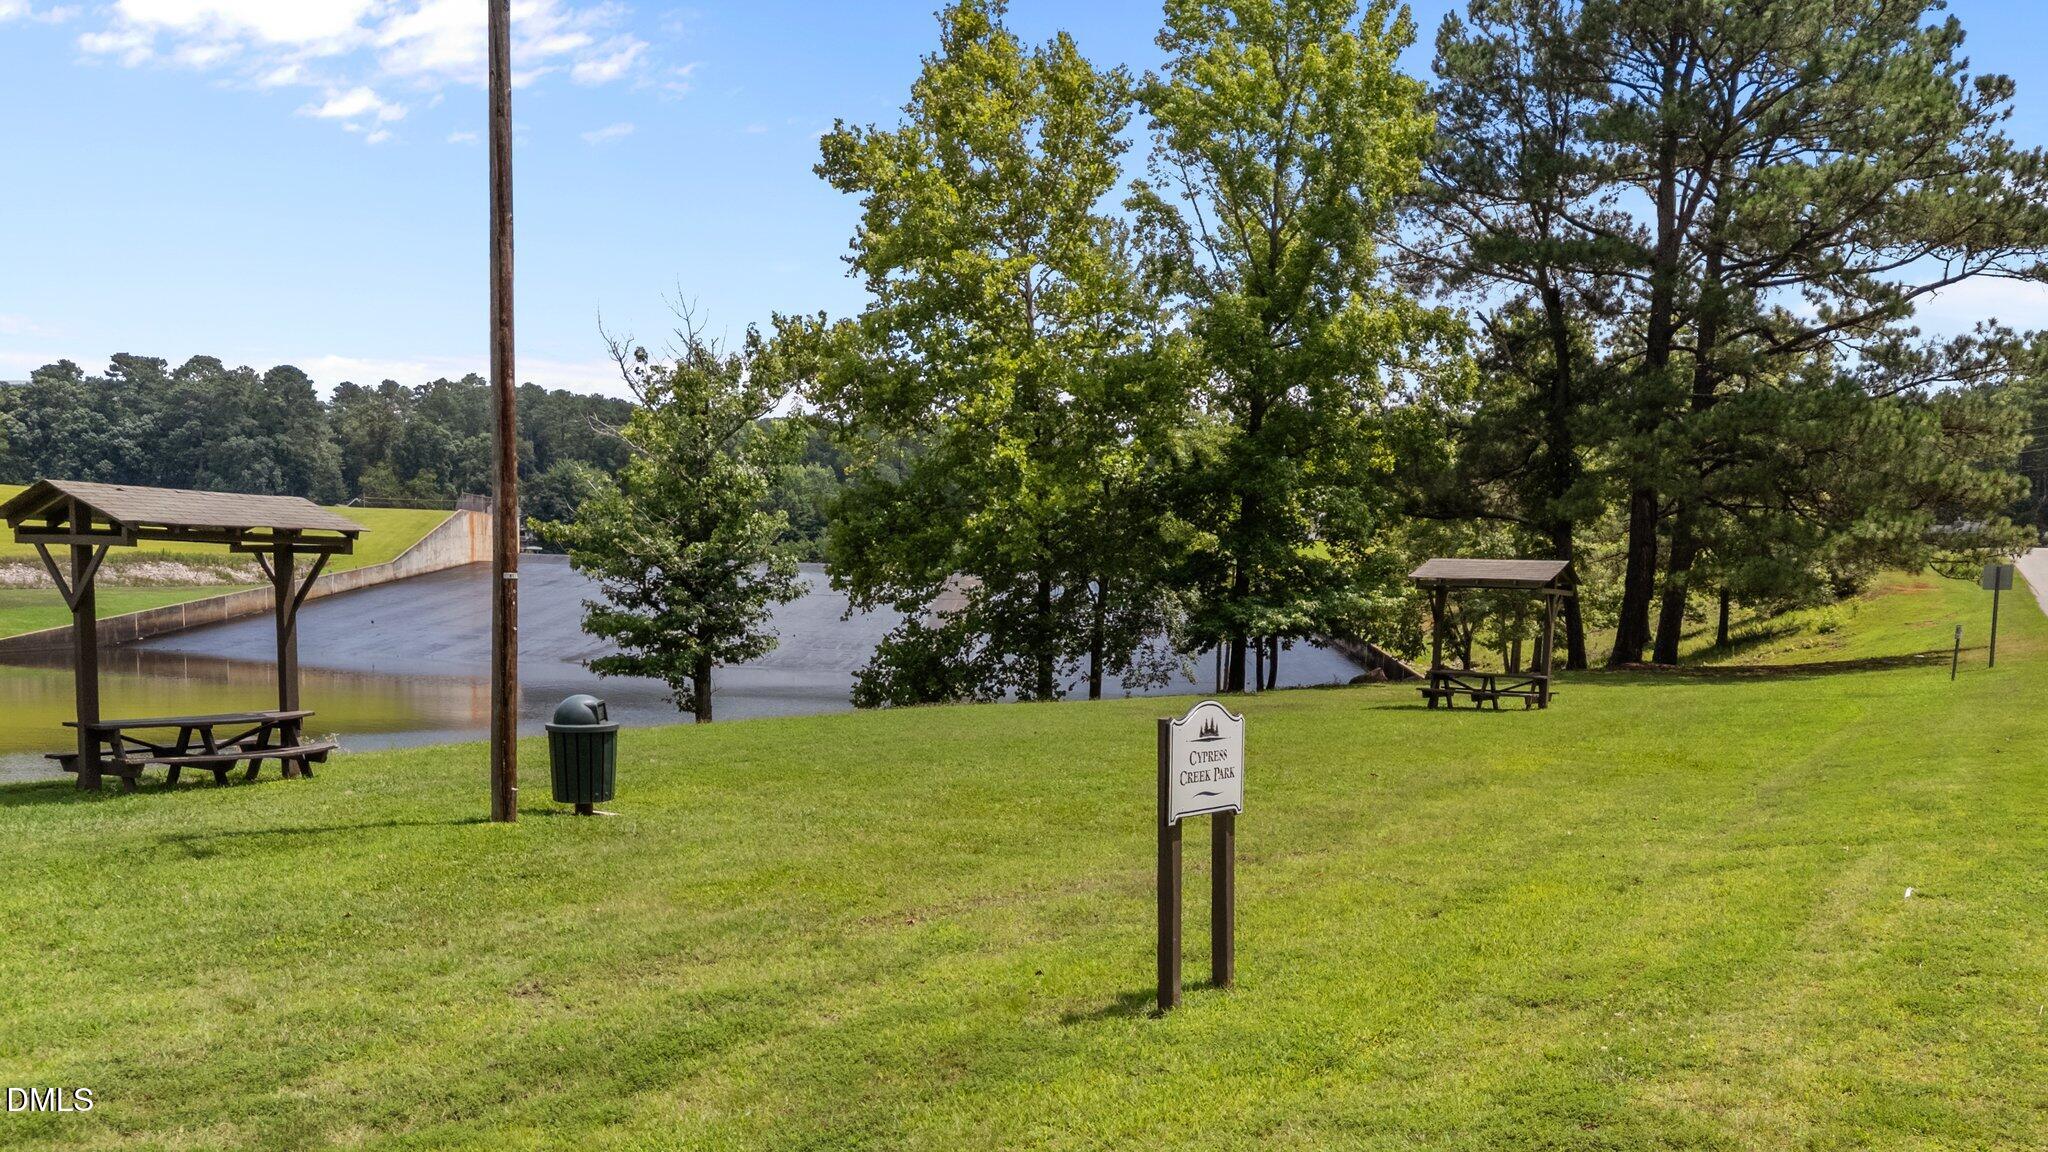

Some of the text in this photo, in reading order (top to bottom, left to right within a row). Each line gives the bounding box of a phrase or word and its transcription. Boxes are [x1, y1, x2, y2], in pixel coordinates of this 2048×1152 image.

[1189, 749, 1228, 766] CYPRESS
[1179, 766, 1235, 786] CREEK PARK
